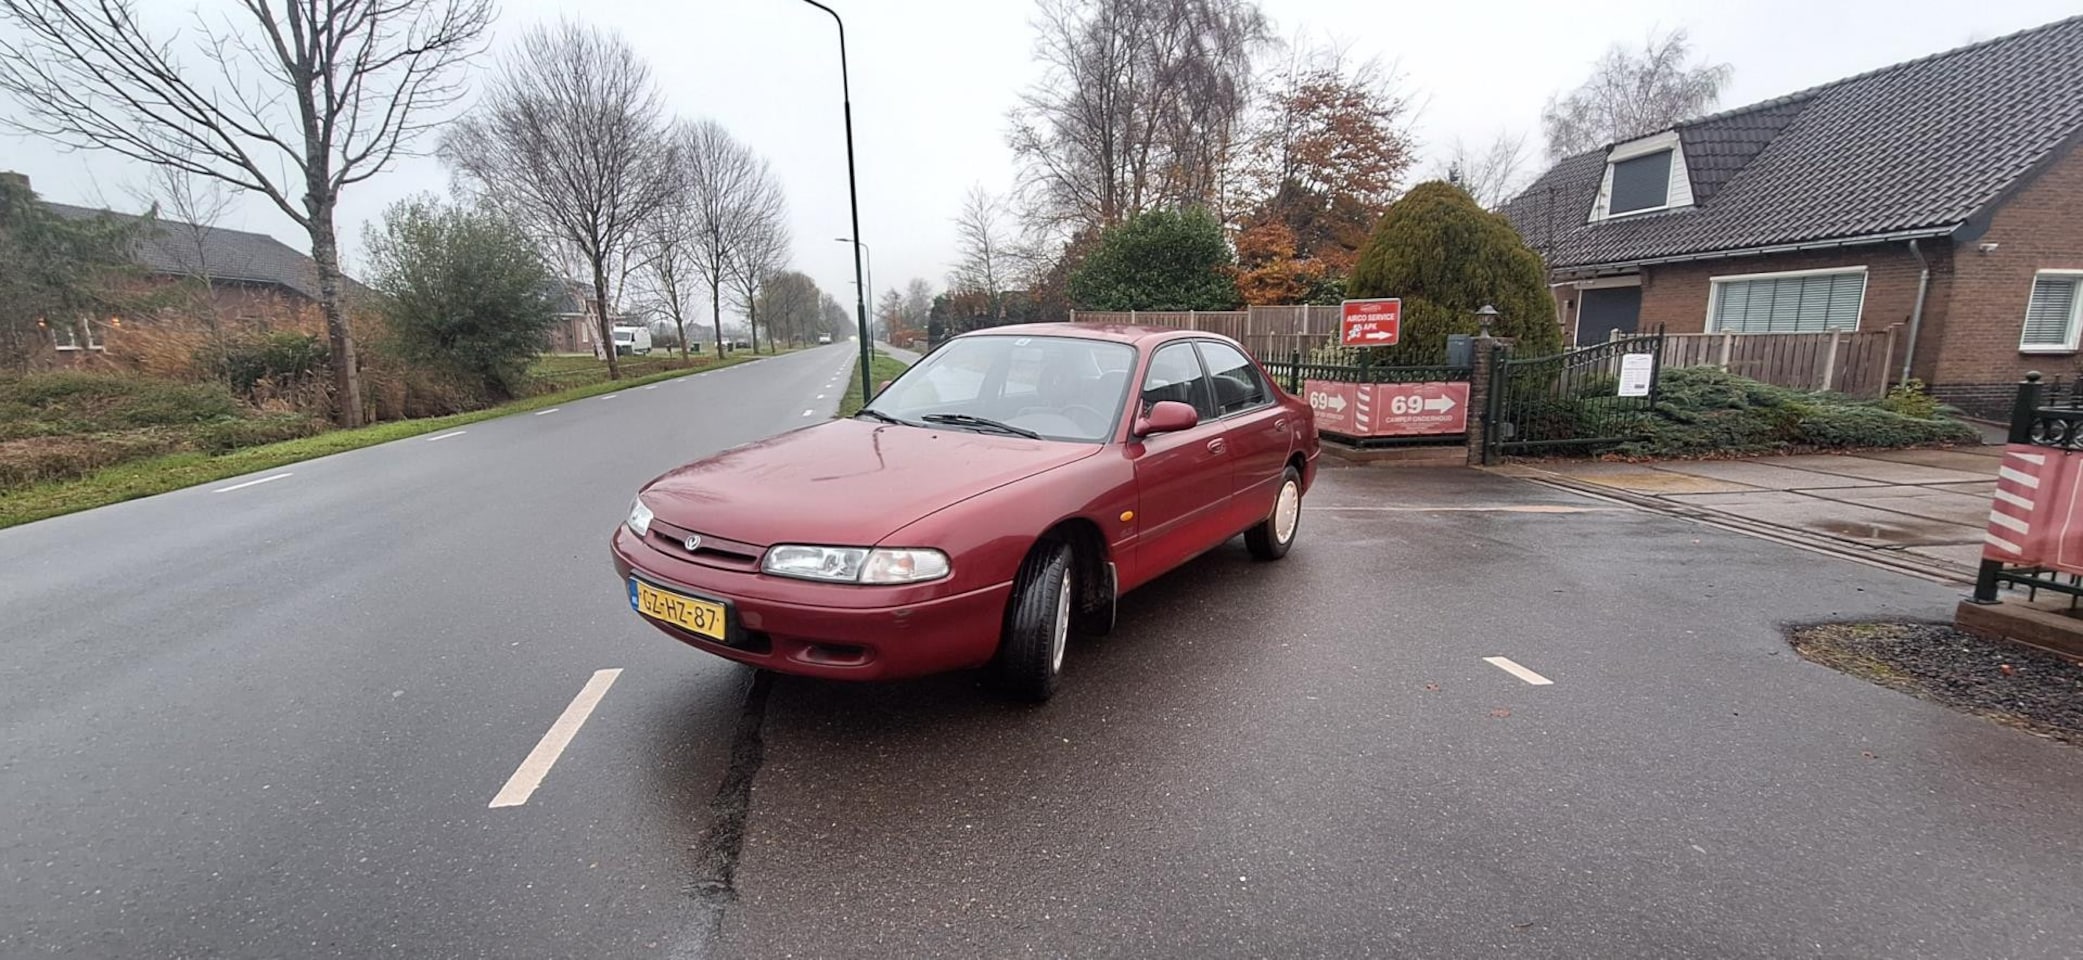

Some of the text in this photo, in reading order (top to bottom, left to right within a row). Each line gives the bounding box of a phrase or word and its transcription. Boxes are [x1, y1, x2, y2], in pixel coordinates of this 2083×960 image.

[1367, 312, 1395, 321] SERVICE
[1310, 391, 1328, 410] 69
[1391, 395, 1423, 415] 69
[1385, 415, 1453, 424] CAMPER ONDERHOUD
[642, 589, 716, 631] GZ-HZ-87
